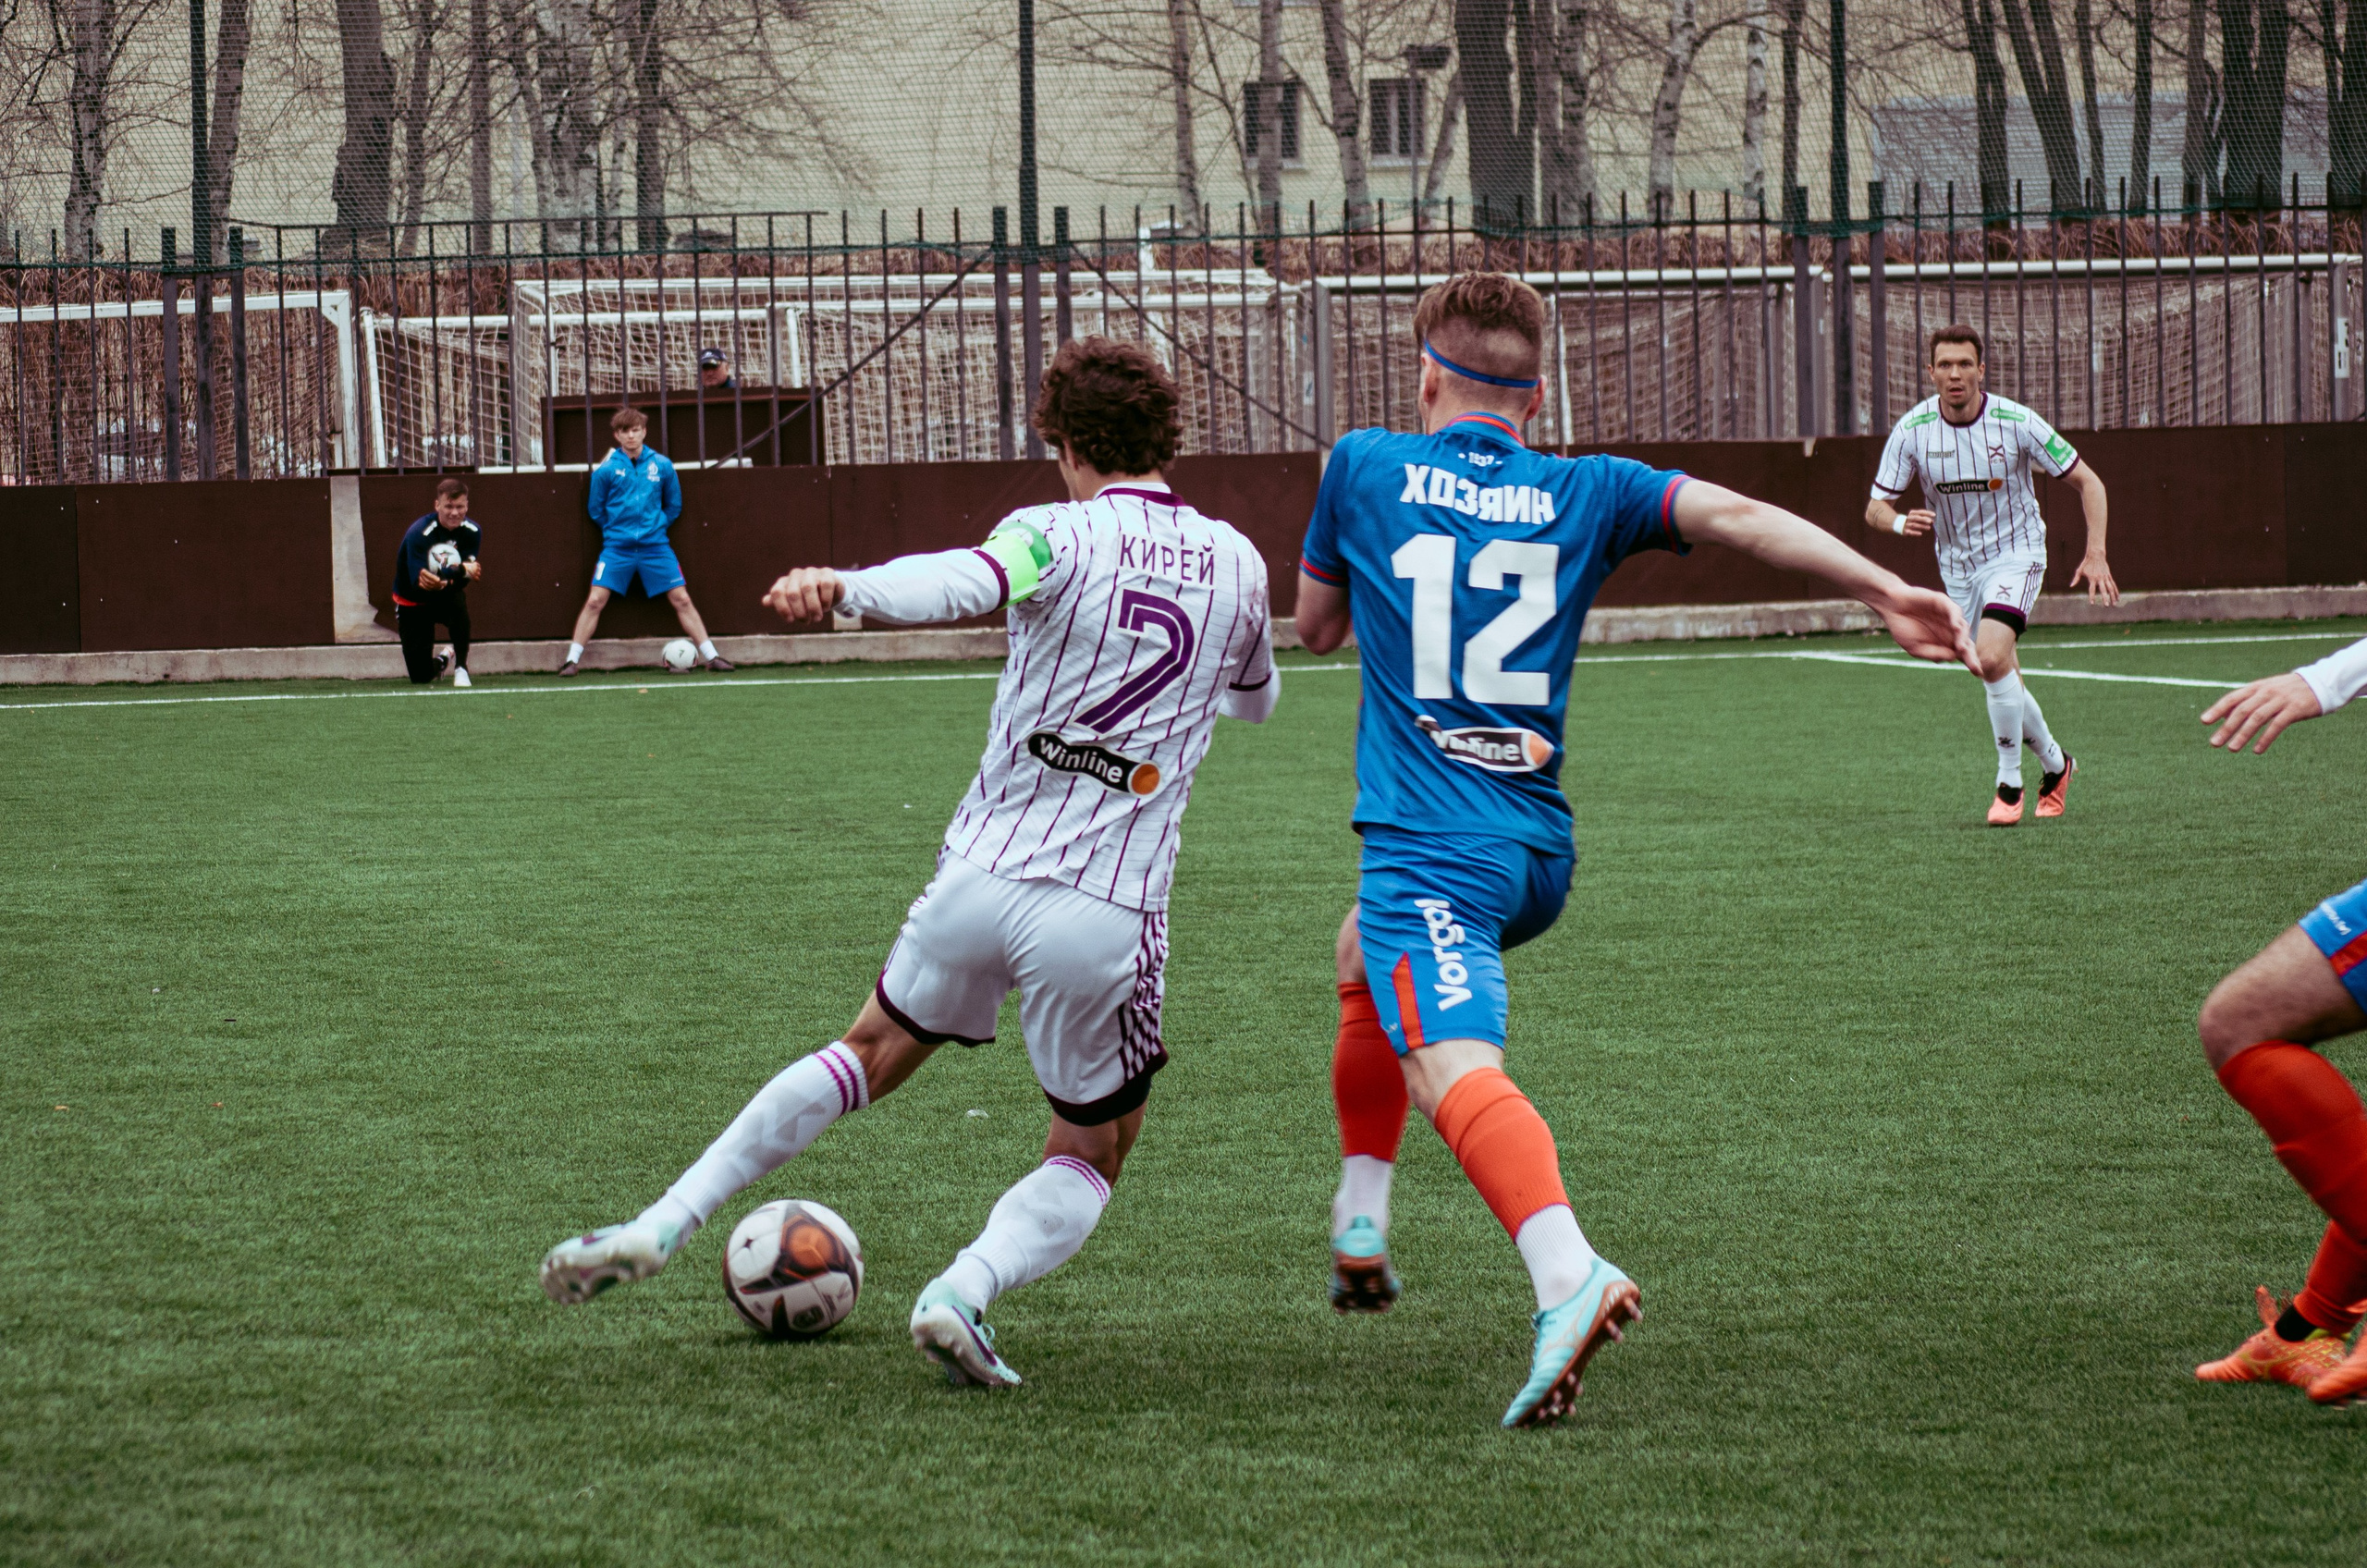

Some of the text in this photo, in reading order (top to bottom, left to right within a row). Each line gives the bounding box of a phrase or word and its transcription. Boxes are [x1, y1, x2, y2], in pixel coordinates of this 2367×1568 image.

[1399, 463, 1556, 524] ХОЗЯИН
[1939, 482, 1985, 493] Winline
[1120, 533, 1215, 585] КИРЕЙ
[1391, 533, 1560, 705] 12
[1039, 737, 1123, 784] Winline
[1414, 899, 1472, 1011] Vorgol
